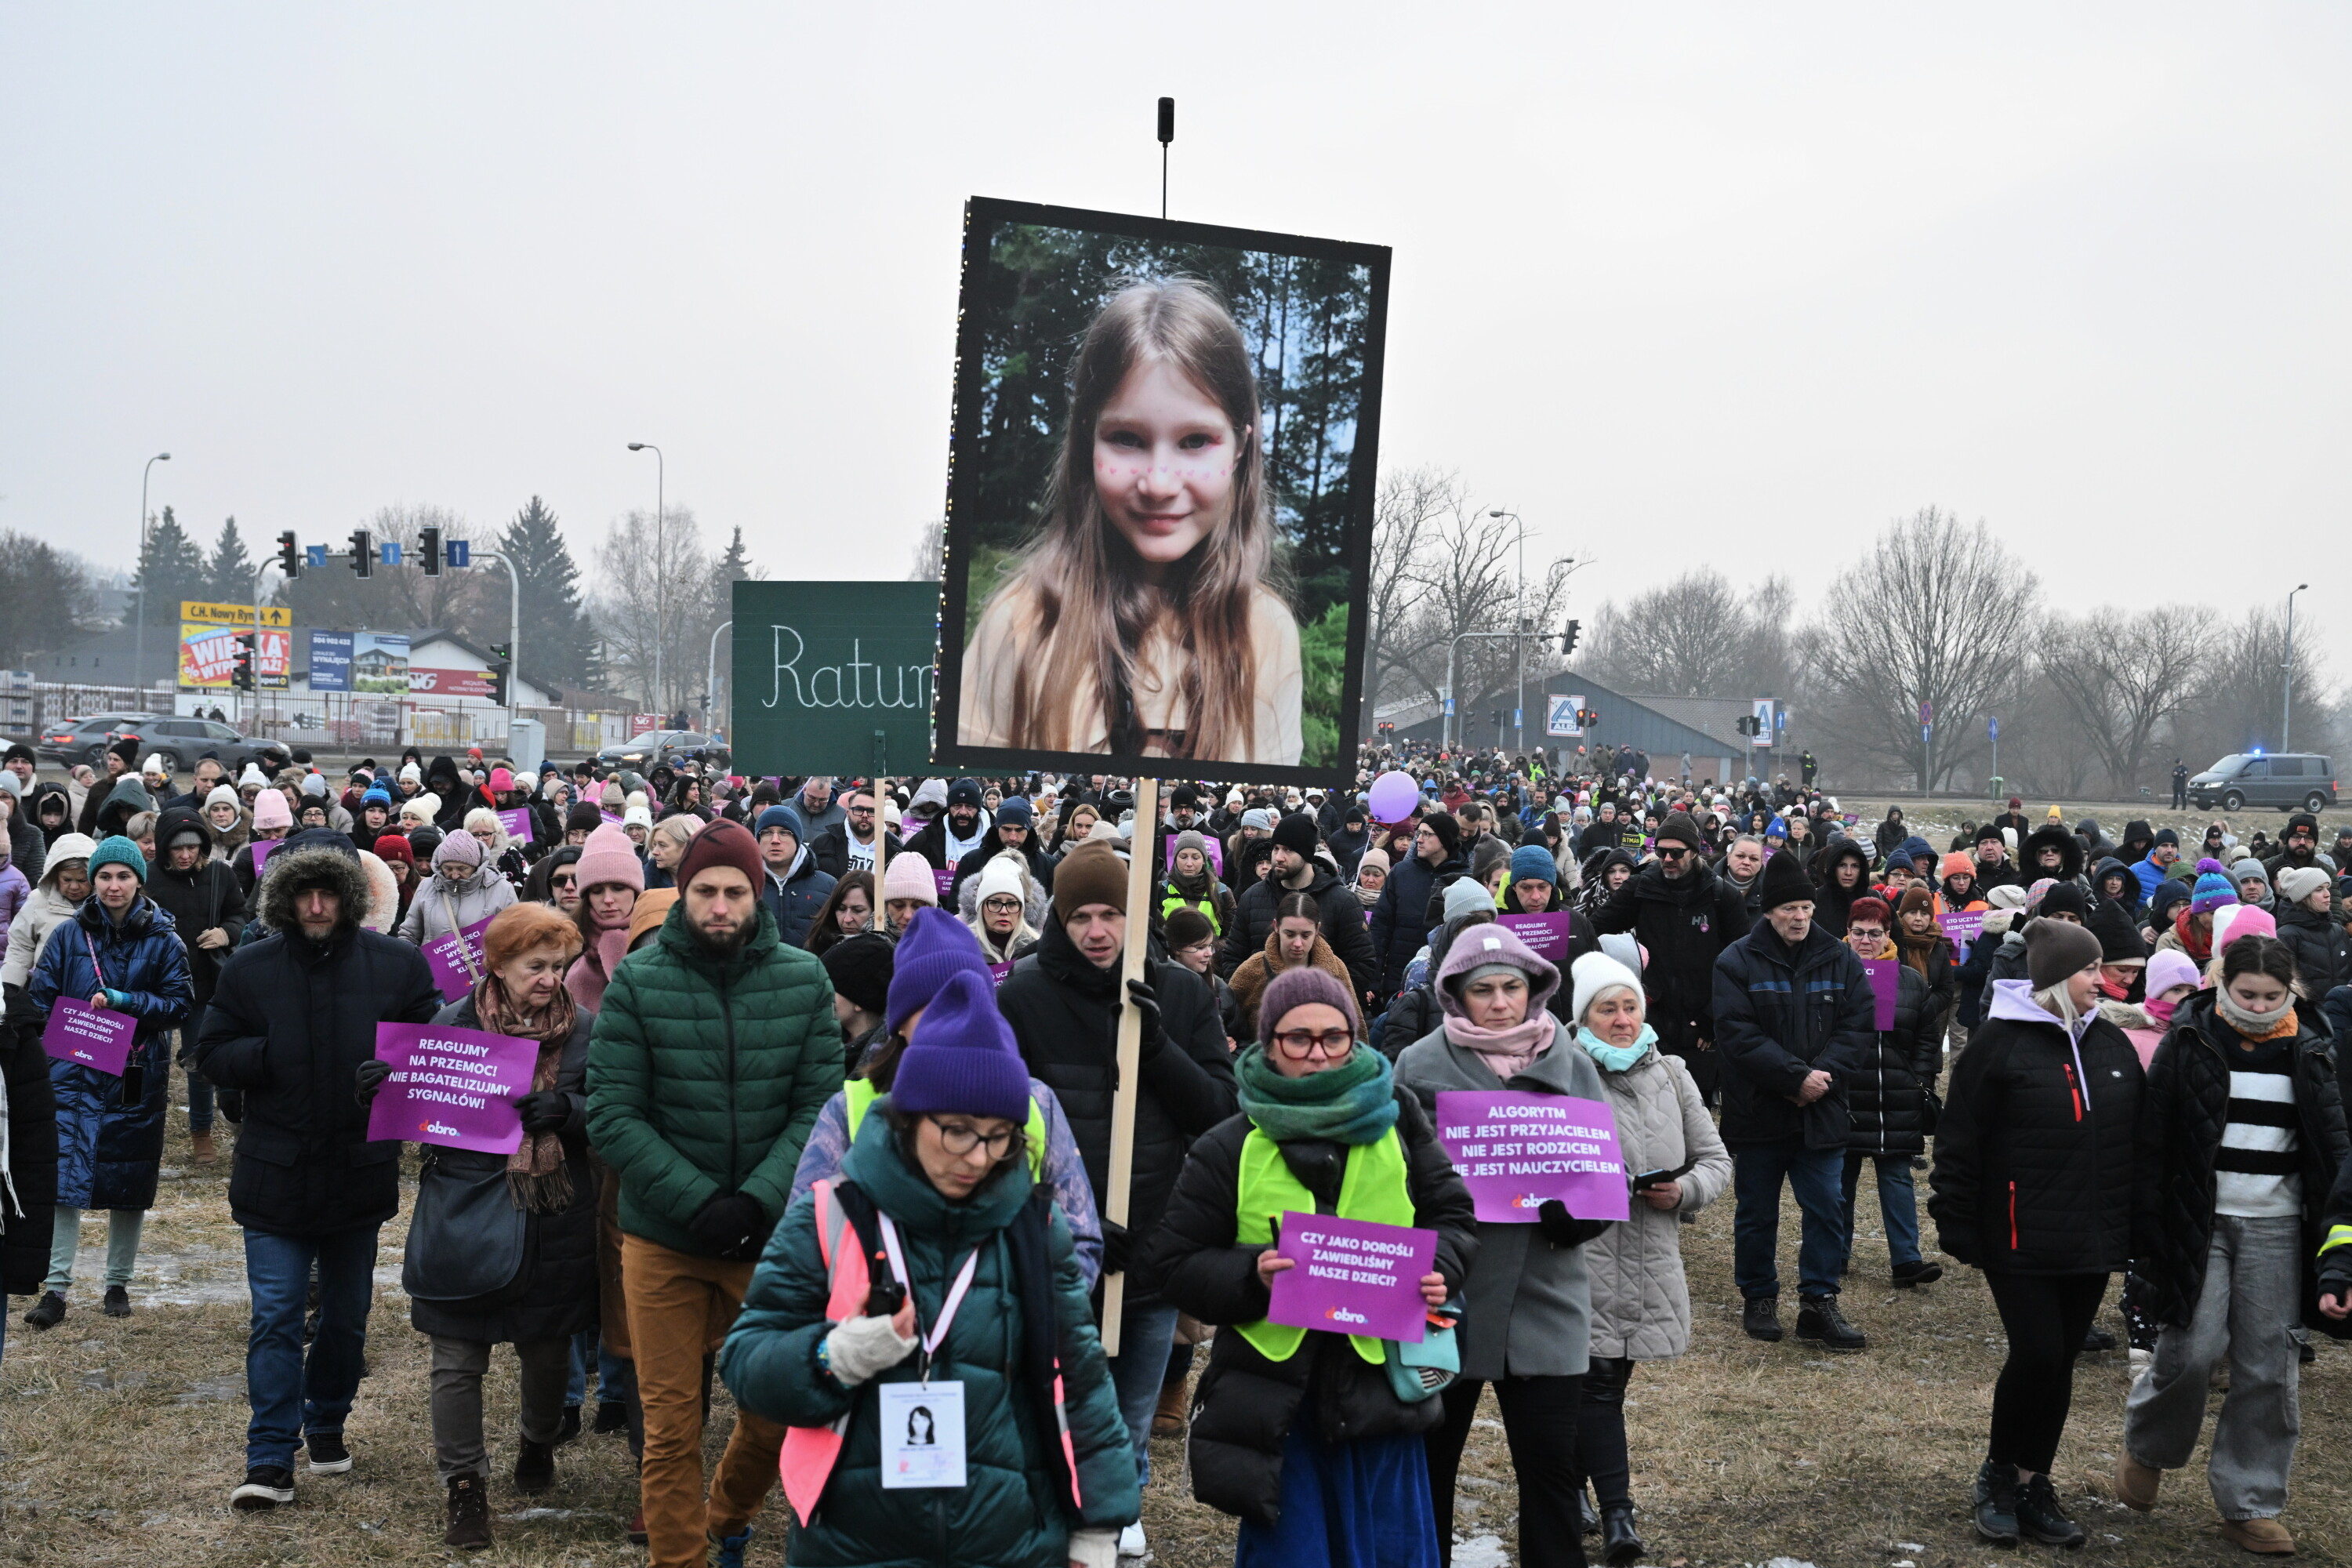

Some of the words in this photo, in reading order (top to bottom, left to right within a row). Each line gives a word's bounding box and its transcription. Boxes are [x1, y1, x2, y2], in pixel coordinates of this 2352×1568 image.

[191, 606, 208, 618] C.H.
[211, 608, 235, 622] Nowy
[238, 609, 265, 622] Rynk
[1553, 723, 1577, 731] ALDI
[433, 939, 458, 954] UCZMY
[462, 931, 481, 942] ZIECI
[448, 958, 461, 968] NIE
[67, 1018, 113, 1035] ZAWIEDLIŚMY
[78, 1011, 96, 1020] JAKO
[96, 1016, 124, 1030] DOROŚLI
[64, 1025, 88, 1036] NASZE
[88, 1032, 114, 1044] DZIECI?
[419, 1039, 489, 1058] REAGUJMY
[409, 1055, 426, 1066] NA
[430, 1056, 498, 1077] PRZEMOC!
[388, 1071, 408, 1083] NIE
[410, 1073, 511, 1096] BAGATELIZUJMY
[407, 1088, 485, 1109] SYGNAŁÓW!
[1488, 1105, 1566, 1119] ALGORYTM
[1446, 1126, 1470, 1139] NIE
[1474, 1124, 1506, 1138] JEST
[1510, 1123, 1611, 1141] PRZYJACIELEM
[1462, 1145, 1486, 1157] NIE
[1490, 1143, 1523, 1156] JEST
[1526, 1142, 1600, 1156] RODZICEM
[1472, 1163, 1504, 1176] JEST
[1509, 1160, 1621, 1174] NAUCZYCIELEM
[1301, 1232, 1326, 1246] CZY
[1327, 1236, 1359, 1250] JAKO
[1362, 1240, 1414, 1258] DOROŚLI
[1312, 1249, 1394, 1270] ZAWIEDLIŚMY
[1308, 1265, 1349, 1280] NASZE
[1352, 1270, 1397, 1287] DZIECI?
